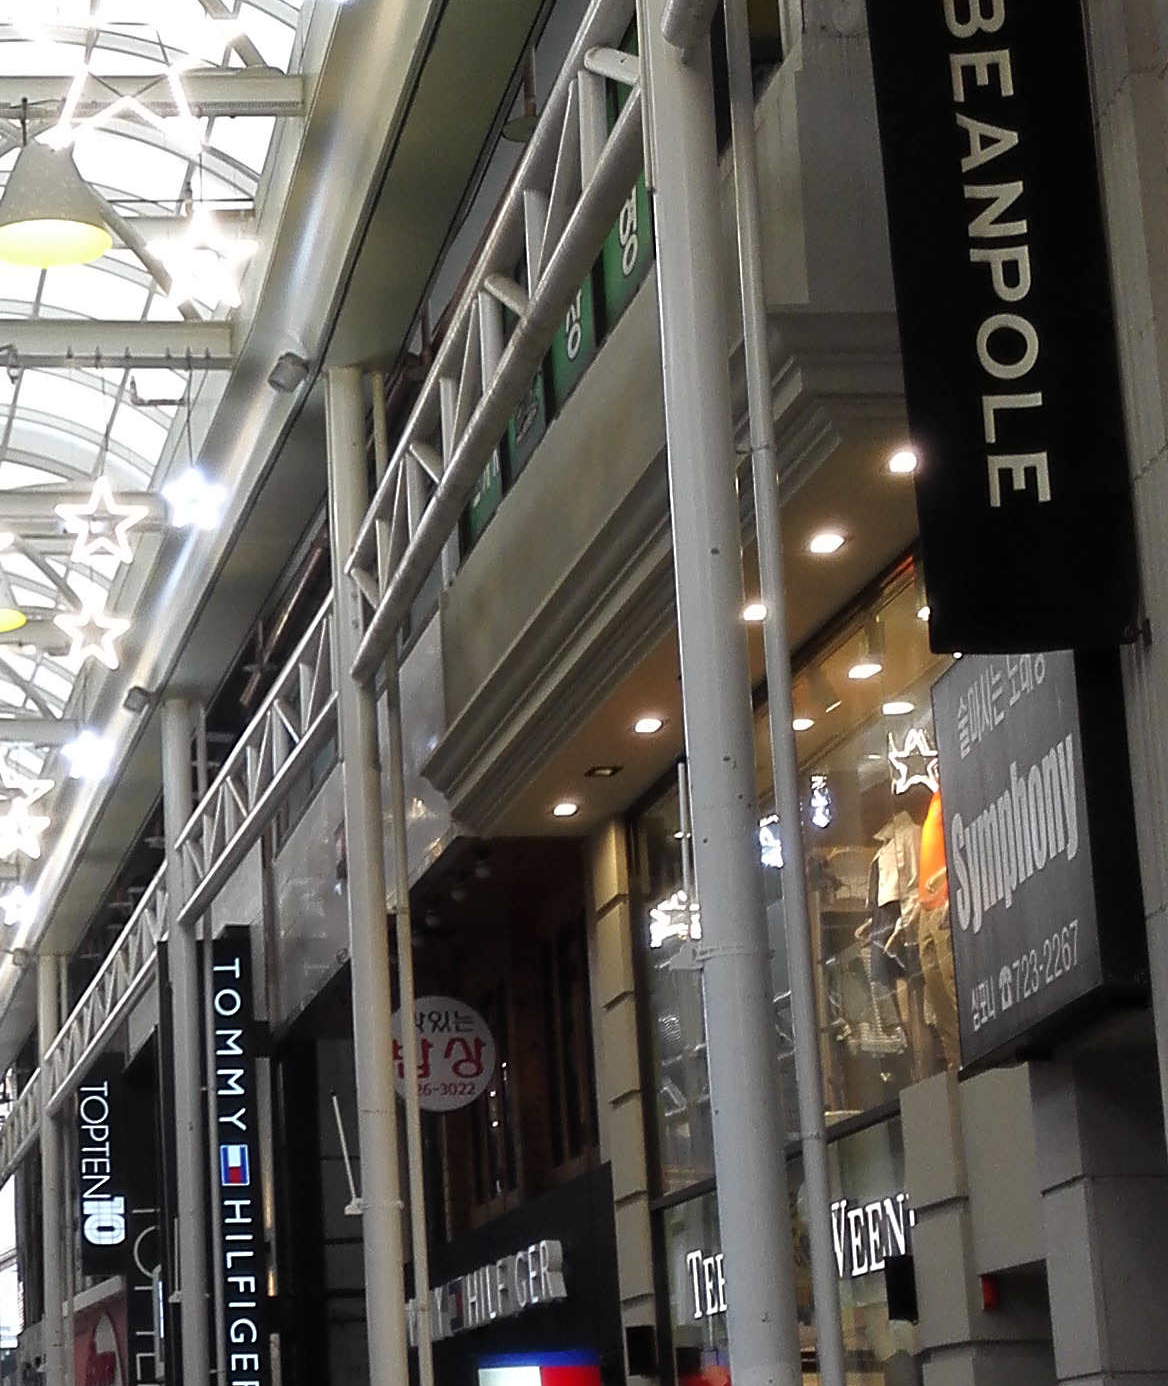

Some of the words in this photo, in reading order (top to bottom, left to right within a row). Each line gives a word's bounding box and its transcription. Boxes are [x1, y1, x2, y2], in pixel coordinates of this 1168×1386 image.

[952, 734, 1079, 933] Symphony
[1012, 918, 1079, 1003] 723-2267
[212, 957, 247, 1132] TOMMY
[79, 1080, 126, 1245] TOPTEN10
[686, 1249, 728, 1319] TEE
